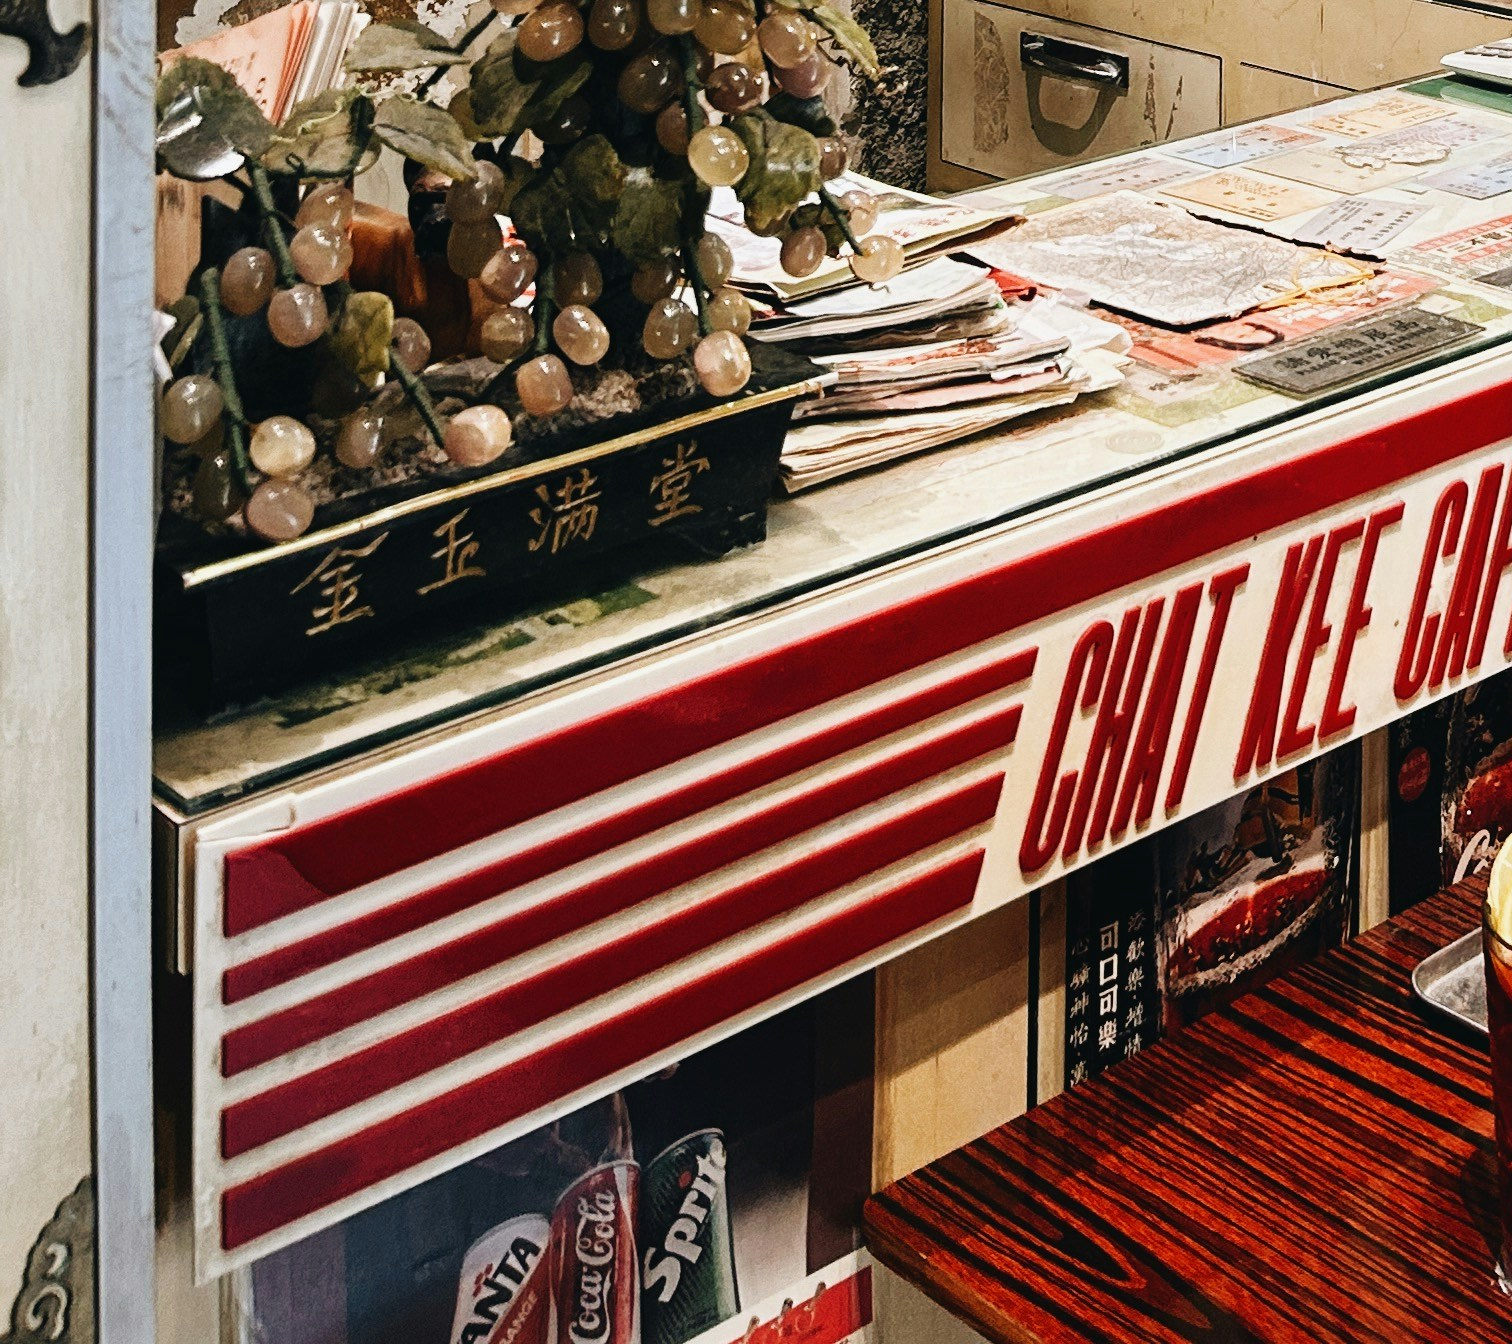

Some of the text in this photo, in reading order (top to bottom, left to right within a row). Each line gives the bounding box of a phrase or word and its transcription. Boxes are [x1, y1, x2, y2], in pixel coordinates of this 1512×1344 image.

[1018, 560, 1251, 875] CHAT
[1234, 499, 1406, 780] KEE
[1098, 919, 1120, 1052] 可口可樂
[456, 1235, 541, 1344] ANTA
